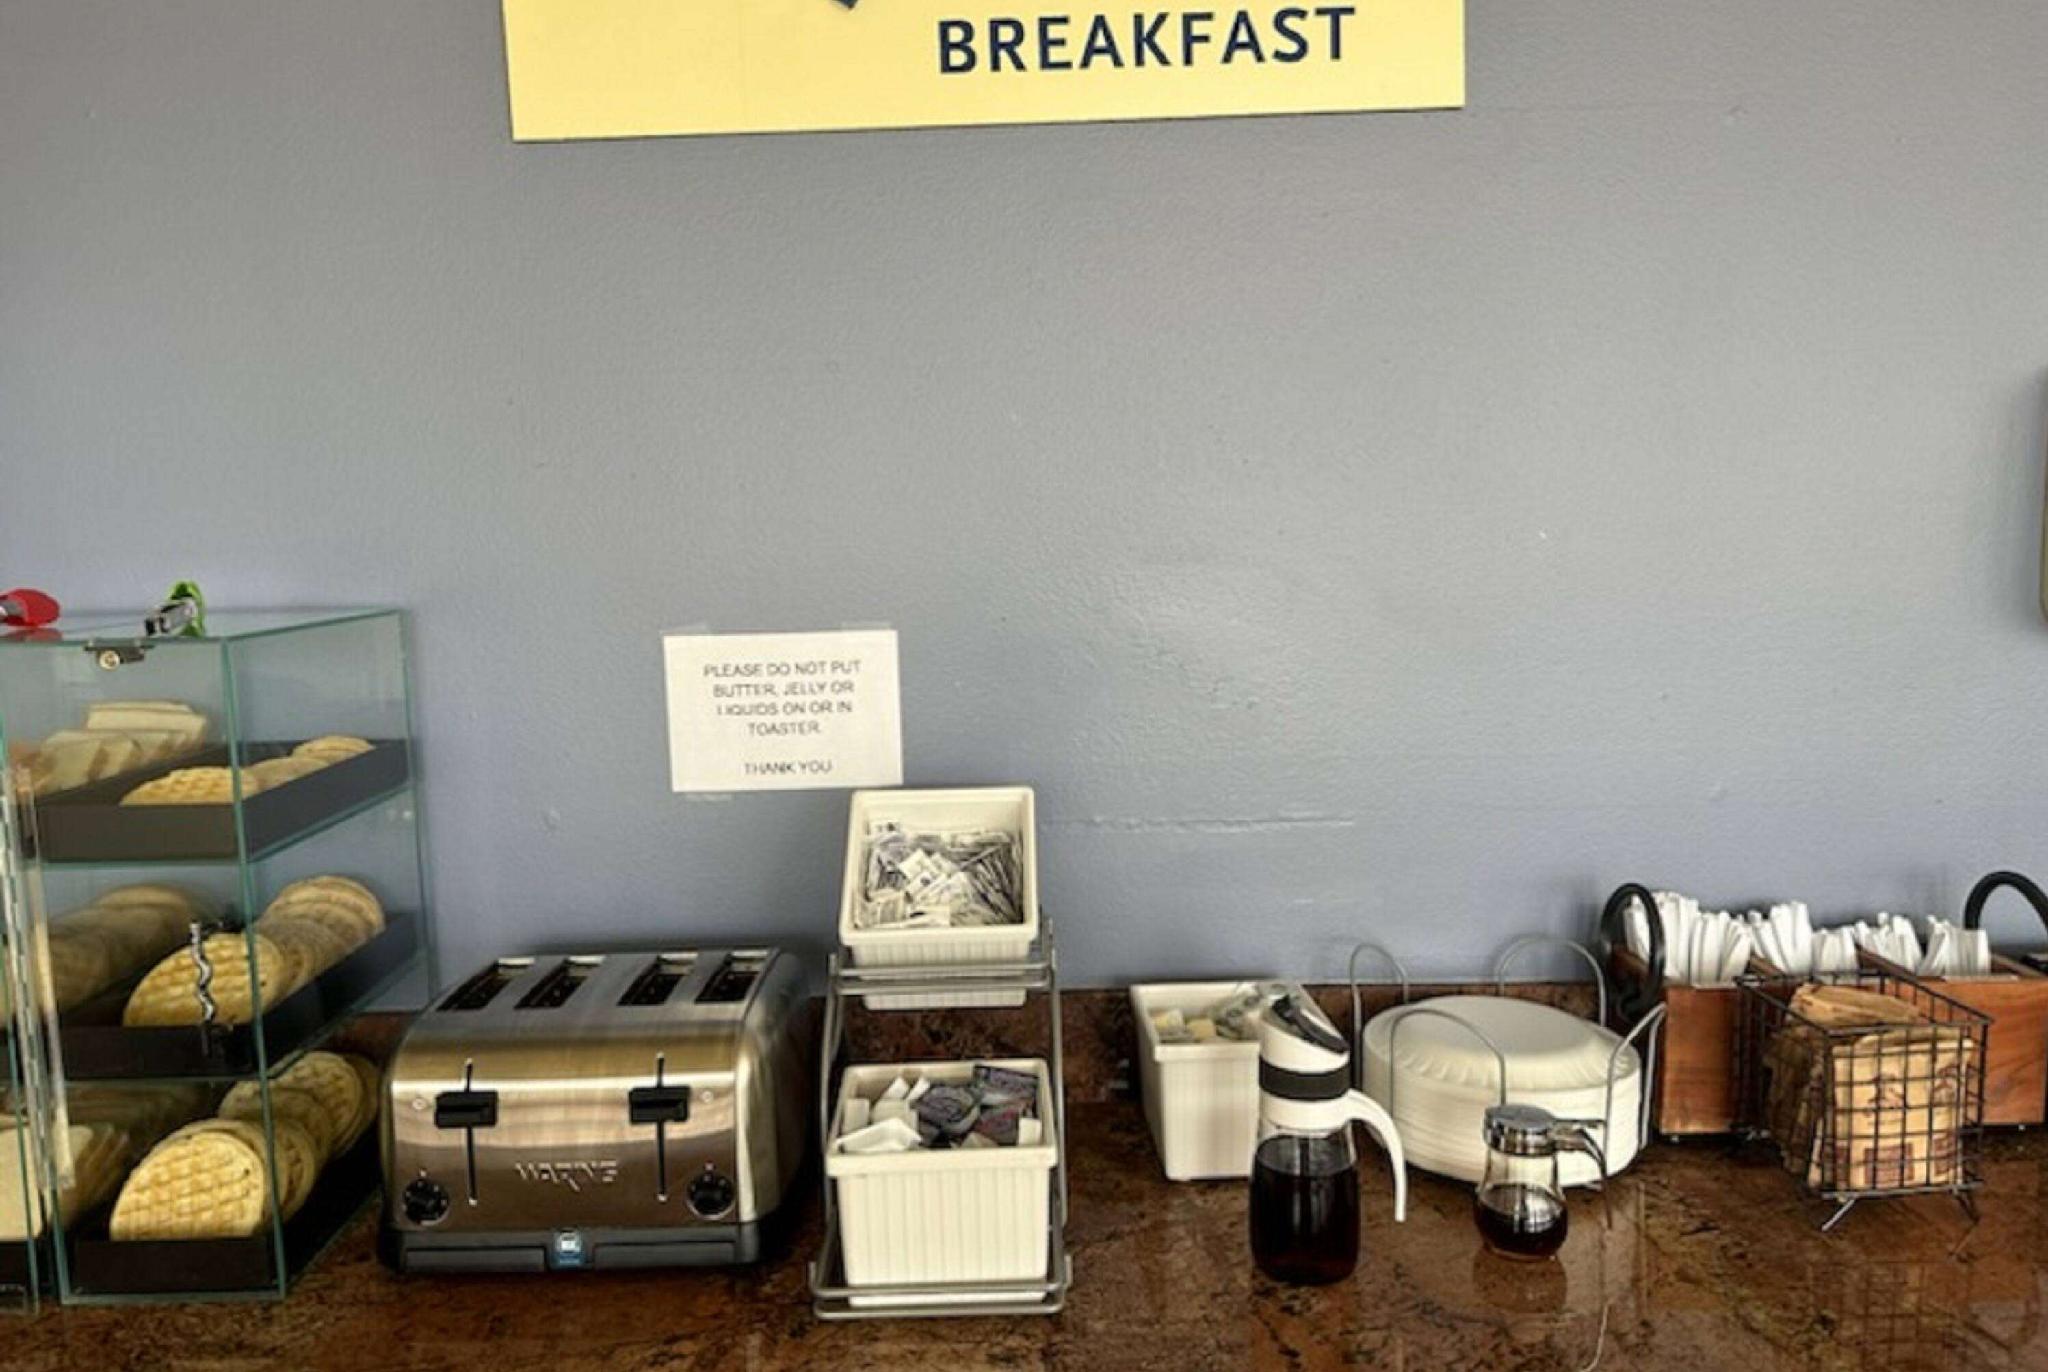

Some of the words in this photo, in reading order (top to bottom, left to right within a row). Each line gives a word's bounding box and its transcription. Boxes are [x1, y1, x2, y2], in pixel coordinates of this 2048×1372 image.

[938, 6, 1355, 73] BREAKFAST
[703, 663, 762, 678] PLEASE
[766, 663, 790, 676] DO
[795, 661, 827, 675] NOT
[830, 660, 861, 674] PUT
[784, 682, 826, 696] JELLY
[830, 680, 855, 695] OR
[716, 703, 779, 716] LIQUIDS
[782, 701, 806, 716] ON
[809, 700, 833, 715] OR
[836, 700, 853, 713] IN
[744, 762, 796, 776] THANK
[799, 760, 832, 775] YOU
